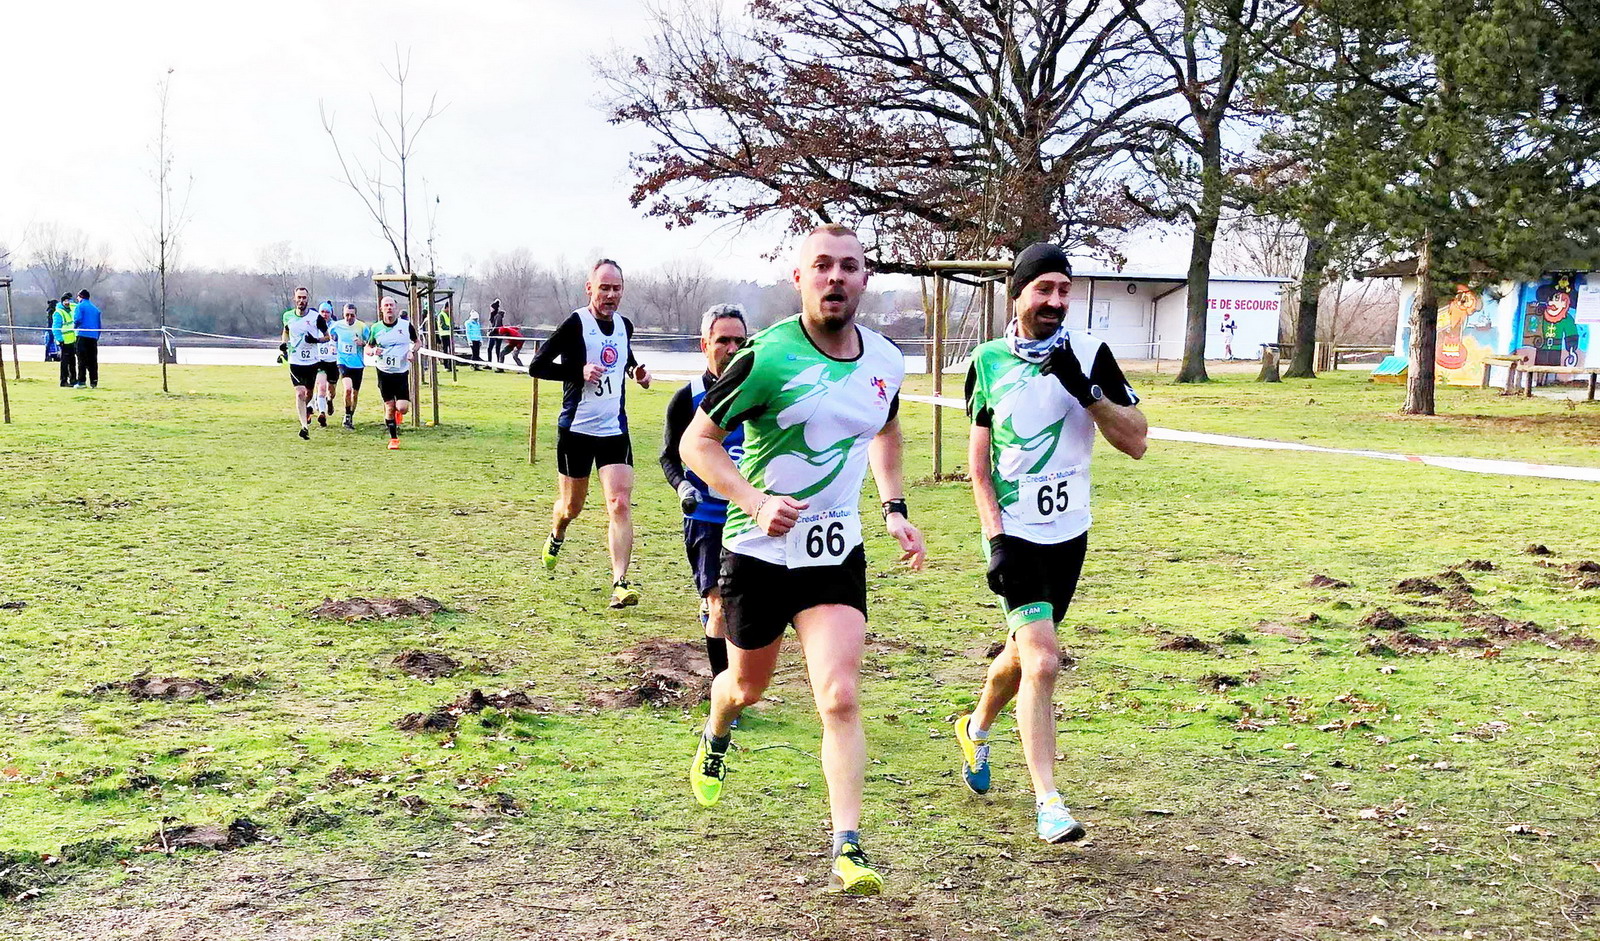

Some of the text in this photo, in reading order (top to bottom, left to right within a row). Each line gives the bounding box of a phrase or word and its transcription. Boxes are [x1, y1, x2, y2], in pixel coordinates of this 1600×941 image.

[1220, 299, 1232, 310] DE
[1234, 299, 1279, 310] SECOURS
[319, 347, 329, 355] 60
[345, 344, 353, 353] 57
[301, 350, 311, 359] 62
[386, 356, 396, 366] 61
[594, 376, 612, 396] 31
[1037, 480, 1069, 516] 65
[806, 521, 845, 559] 66
[1021, 606, 1041, 617] TEAM
